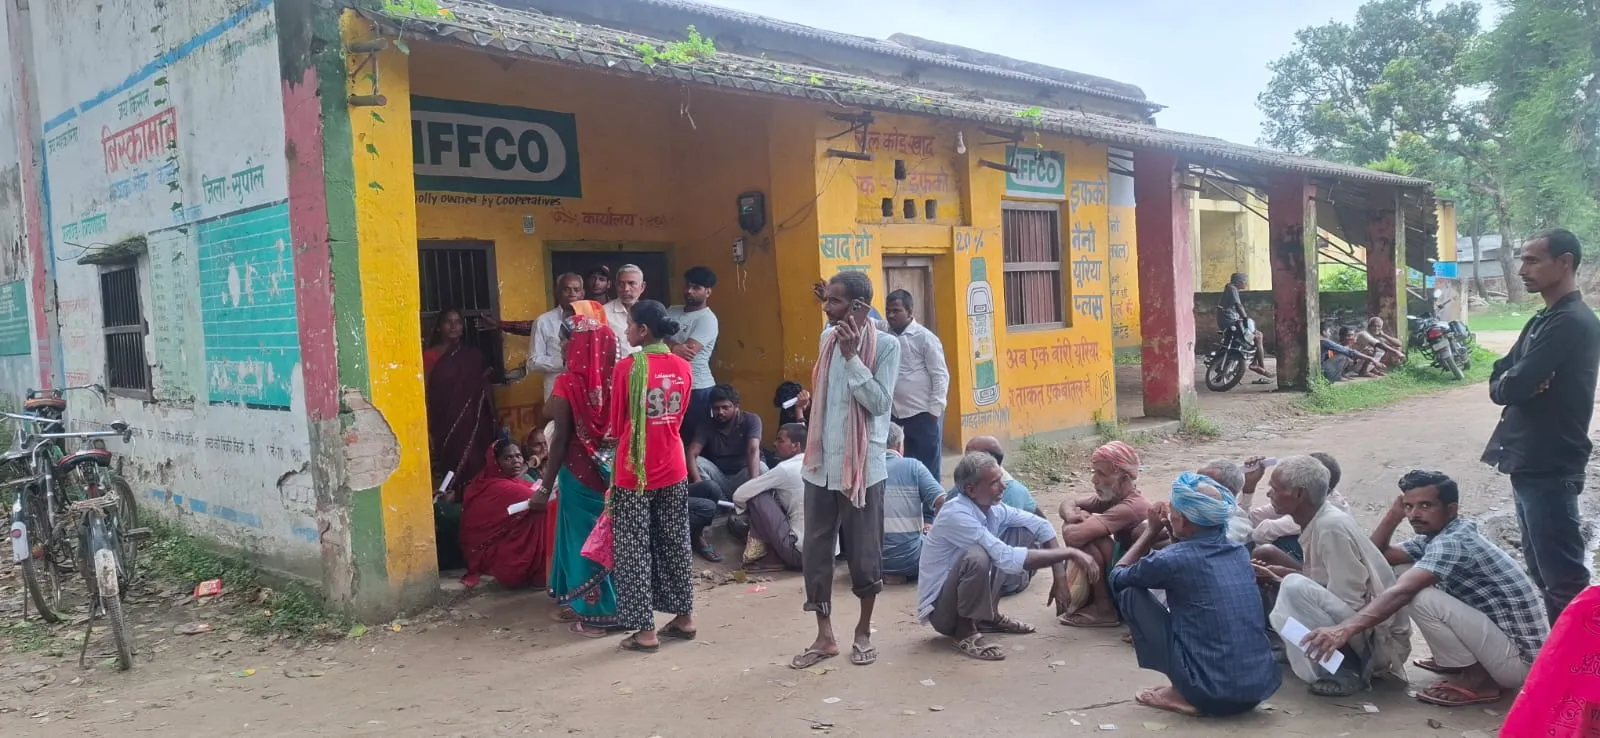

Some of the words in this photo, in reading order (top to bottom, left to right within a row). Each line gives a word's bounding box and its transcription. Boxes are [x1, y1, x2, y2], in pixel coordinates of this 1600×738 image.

[412, 120, 549, 174] IFFCO
[1015, 158, 1056, 183] IFFCO
[415, 192, 438, 205] olly
[482, 194, 495, 208] by
[1070, 174, 1106, 213] इफको
[820, 233, 851, 260] खाद
[854, 228, 873, 261] तो
[1071, 224, 1096, 251] नैनो
[1072, 255, 1102, 288] यूरिया
[1073, 294, 1104, 320] प्लस
[1006, 348, 1028, 369] अब
[1031, 346, 1049, 370] एक
